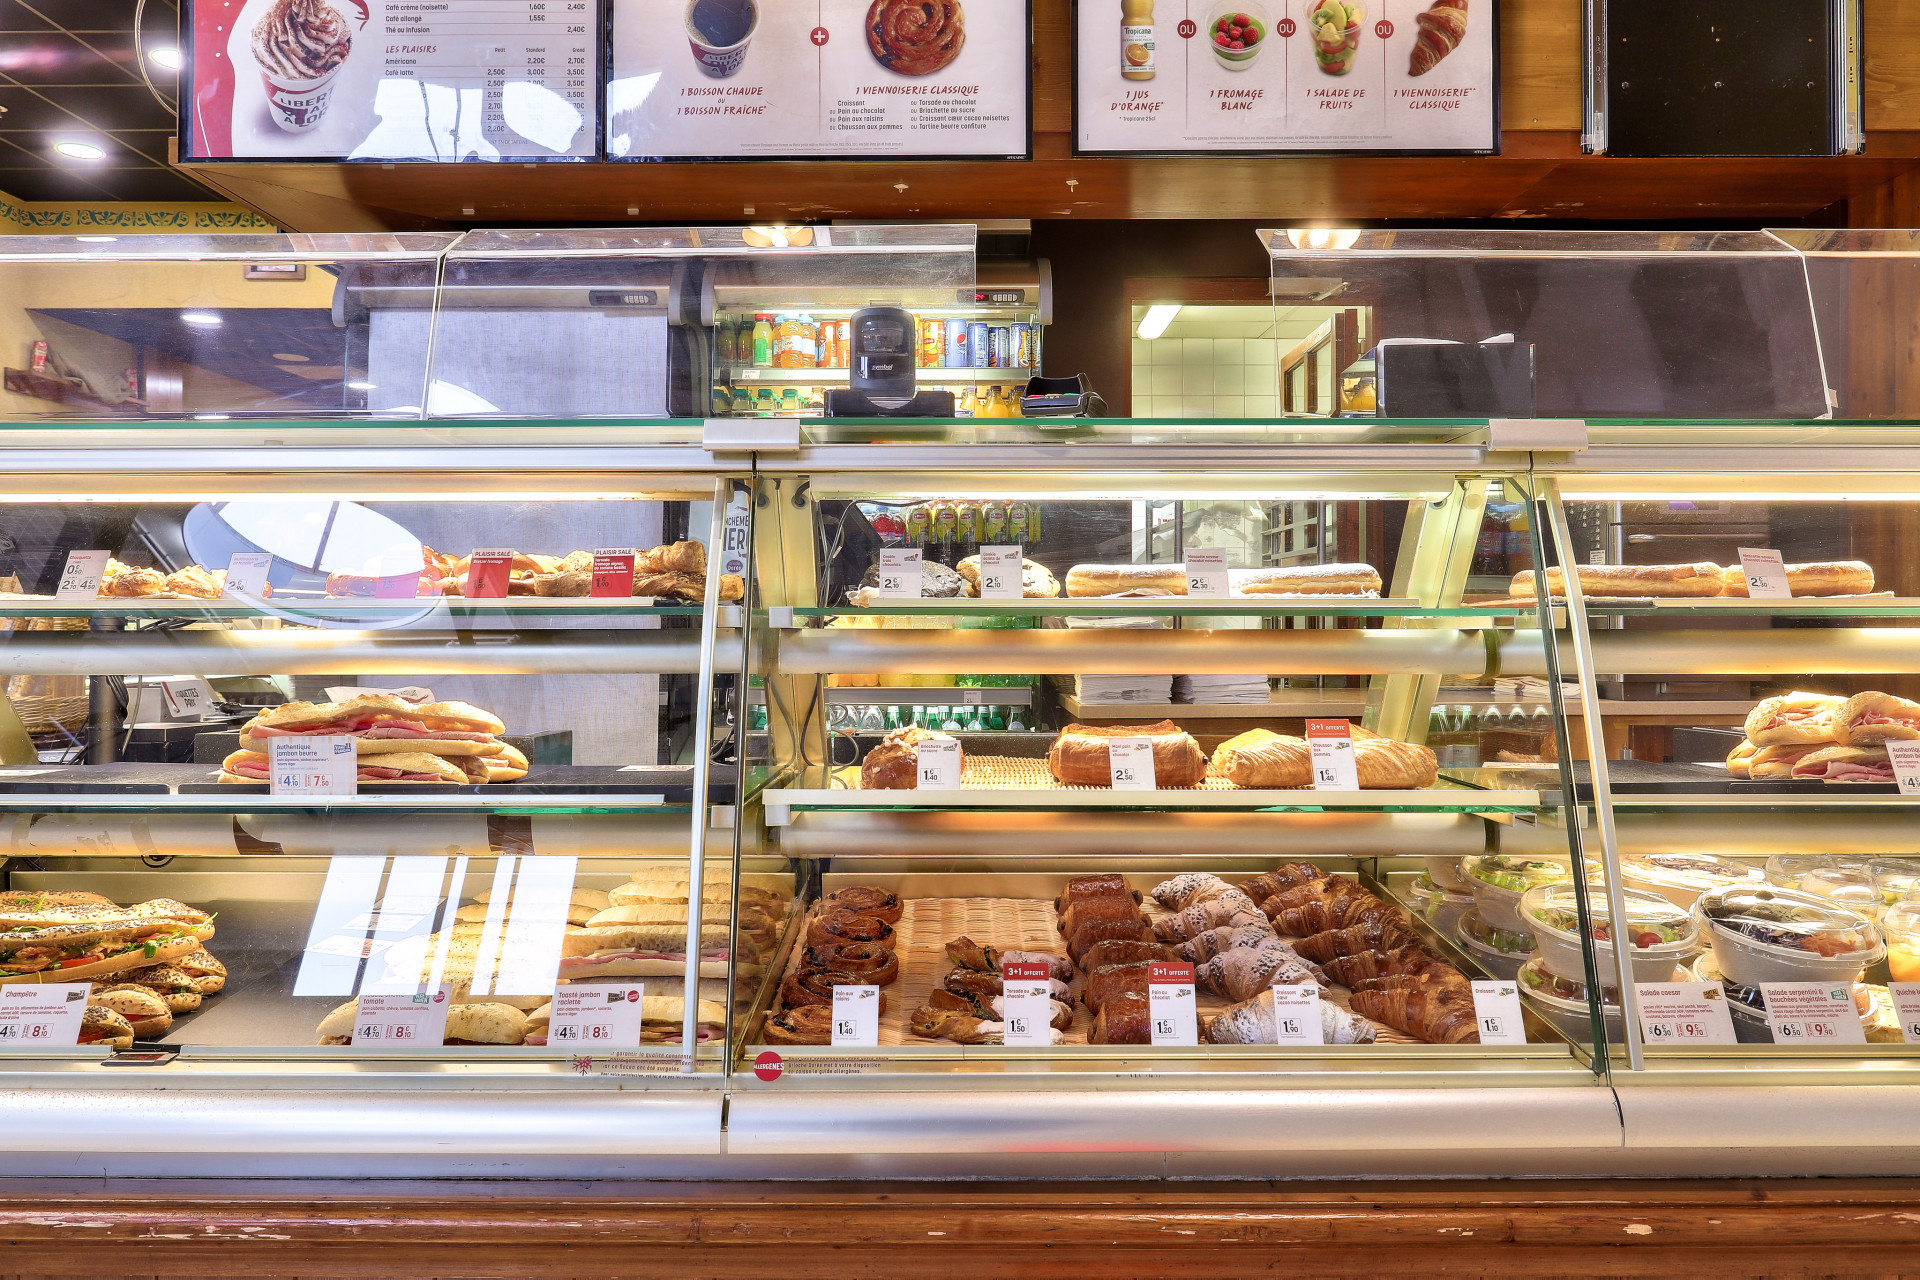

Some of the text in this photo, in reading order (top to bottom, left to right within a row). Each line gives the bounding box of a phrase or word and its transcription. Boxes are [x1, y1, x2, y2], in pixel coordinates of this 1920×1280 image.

[400, 15, 422, 24] allongé
[1180, 24, 1194, 35] OU
[1279, 24, 1293, 34] OU
[1377, 25, 1392, 35] OU
[688, 87, 724, 96] BOISSON
[726, 87, 763, 95] CHAUDE
[863, 86, 928, 95] VIENNOISERIE
[930, 85, 979, 96] CLASSIQUE
[1217, 89, 1264, 100] FROMAGE
[1314, 89, 1350, 97] SALADE
[1131, 90, 1149, 101] JUS
[1221, 102, 1253, 110] BLANC
[1320, 101, 1353, 109] FRUITS
[1409, 101, 1460, 111] CLASSIQUE
[684, 107, 720, 115] BOISSON
[184, 699, 196, 708] PRIX
[1008, 968, 1021, 976] 3+1
[1153, 968, 1166, 976] 3+1
